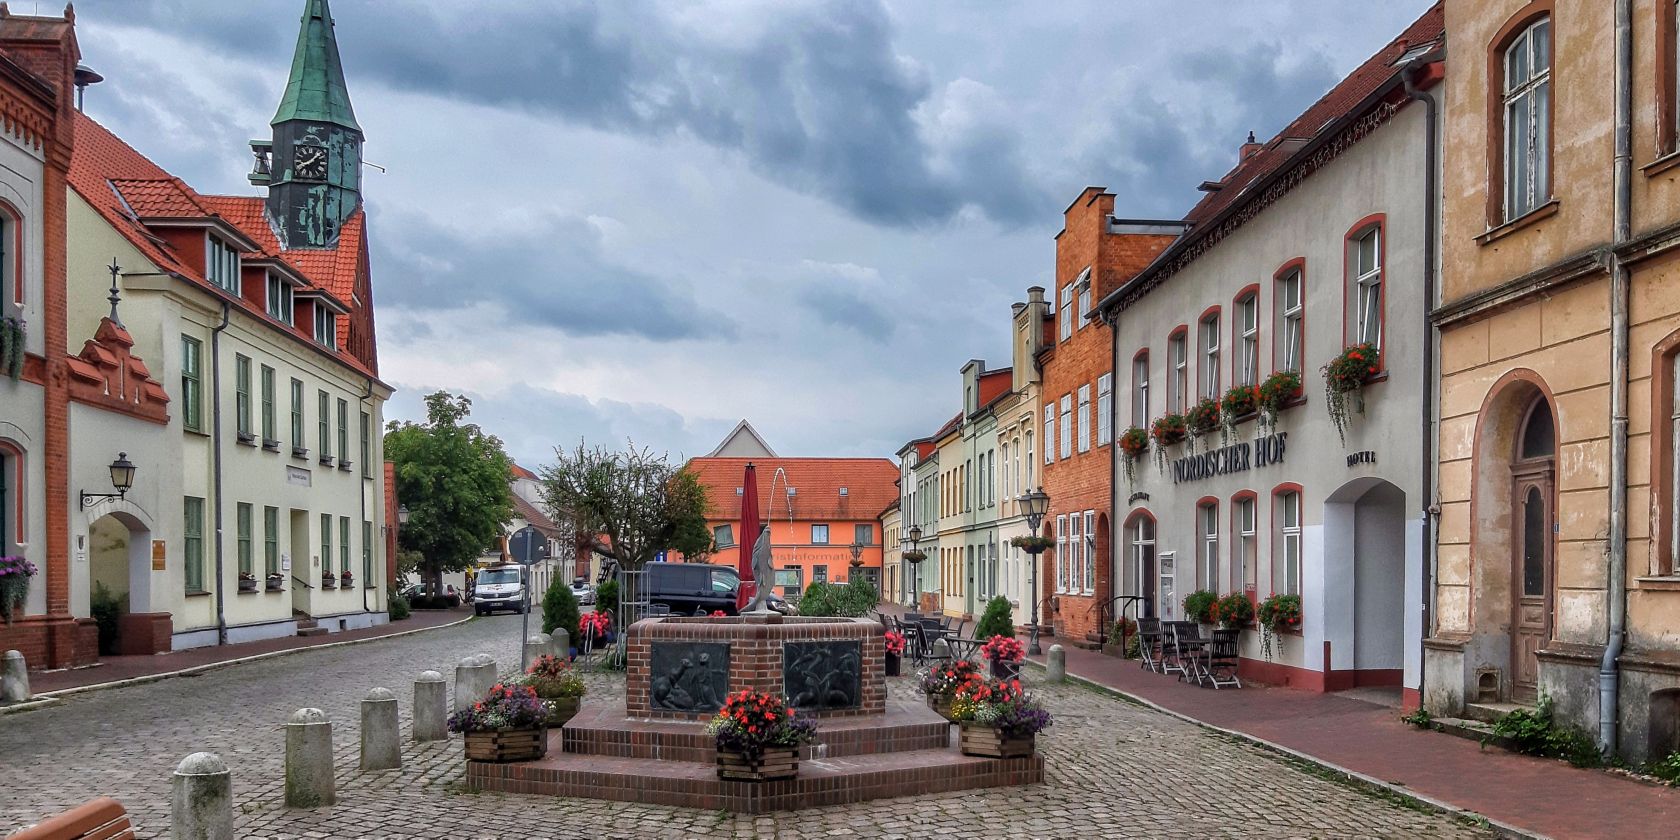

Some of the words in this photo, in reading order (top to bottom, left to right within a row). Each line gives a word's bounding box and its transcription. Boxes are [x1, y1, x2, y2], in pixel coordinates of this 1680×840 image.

[1173, 442, 1250, 485] NORDISCHER
[1254, 432, 1288, 468] HOF
[1346, 451, 1376, 467] HOTEL
